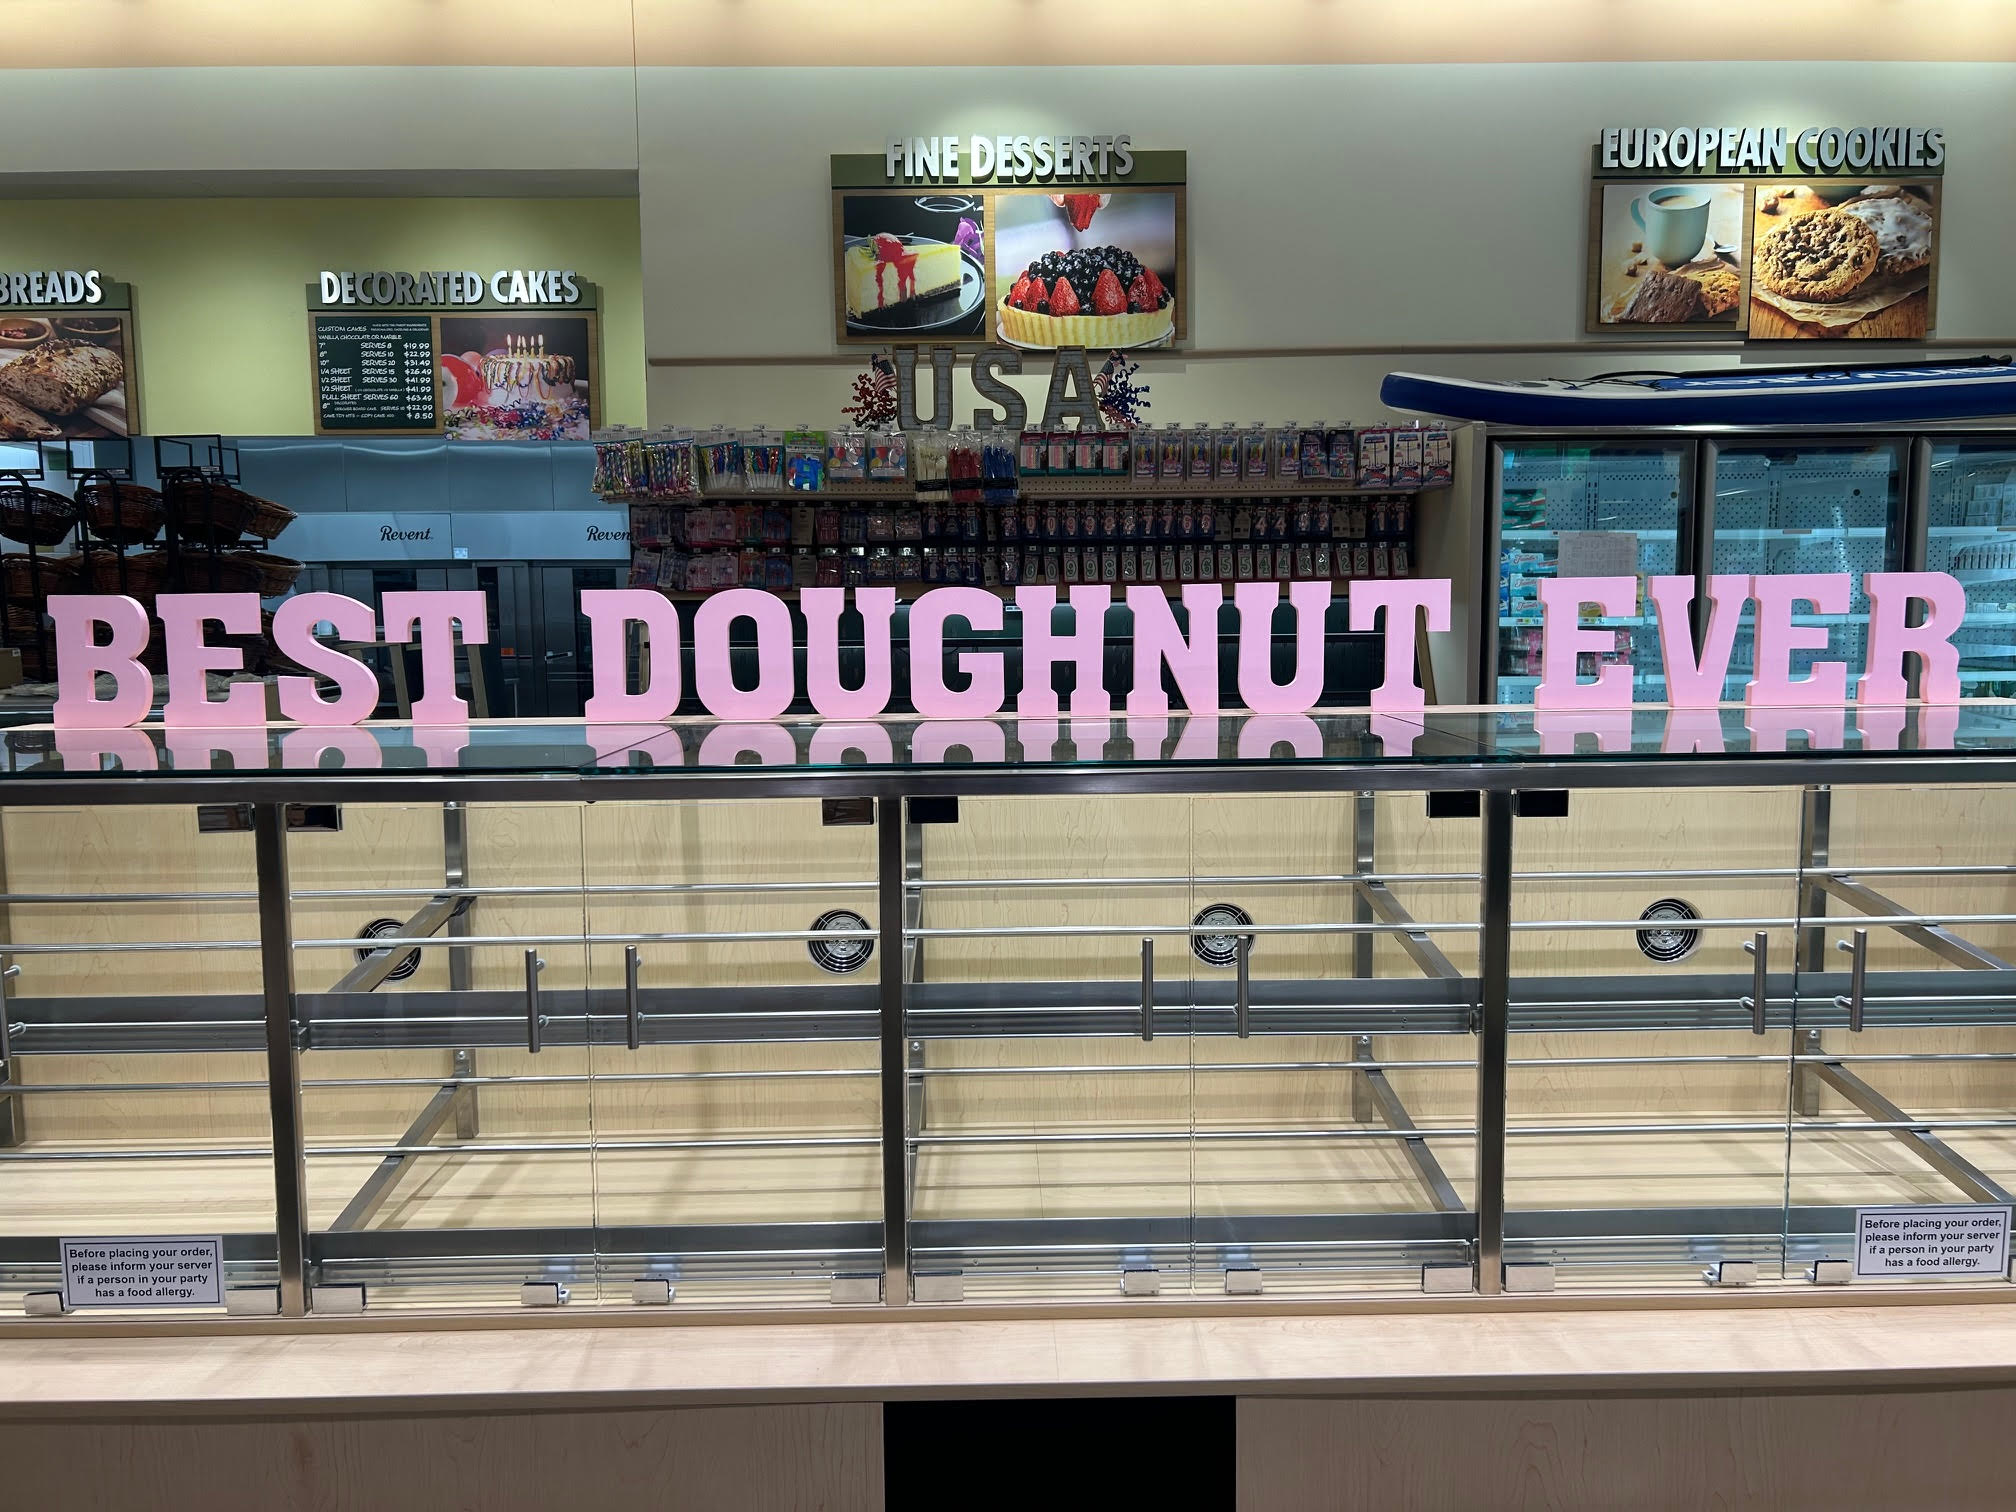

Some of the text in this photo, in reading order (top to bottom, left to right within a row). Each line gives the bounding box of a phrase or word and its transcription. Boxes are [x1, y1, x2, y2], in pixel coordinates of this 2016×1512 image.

[1601, 126, 1944, 169] EUROPEAN COOKIES
[885, 133, 1135, 180] FINE DESSERTS
[320, 269, 580, 305] DECORATED CAKES
[403, 342, 430, 350] $19.99
[404, 359, 430, 367] $31.49
[893, 345, 1106, 431] USA
[379, 524, 431, 542] Revent
[586, 524, 631, 542] Reven
[47, 571, 1967, 728] BEST DOUGHNUT EVER
[1865, 1218, 2002, 1229] Before placing your order,
[1865, 1232, 2000, 1243] please inform your server
[70, 1248, 213, 1259] Before placing your order,
[1869, 1246, 1878, 1254] if
[1888, 1246, 1925, 1255] person
[1928, 1245, 1937, 1253] in
[1941, 1245, 1965, 1255] your
[1967, 1244, 1994, 1254] party
[72, 1261, 212, 1273] please inform your server
[1885, 1258, 1904, 1266] has
[1916, 1257, 1940, 1266] food
[1942, 1256, 1980, 1267] allergy.
[77, 1275, 86, 1284] if
[97, 1277, 135, 1286] person
[138, 1275, 149, 1283] in
[152, 1276, 177, 1285] your
[180, 1274, 208, 1284] party
[95, 1289, 115, 1297] has
[127, 1288, 152, 1296] food
[155, 1288, 195, 1297] allergy.
